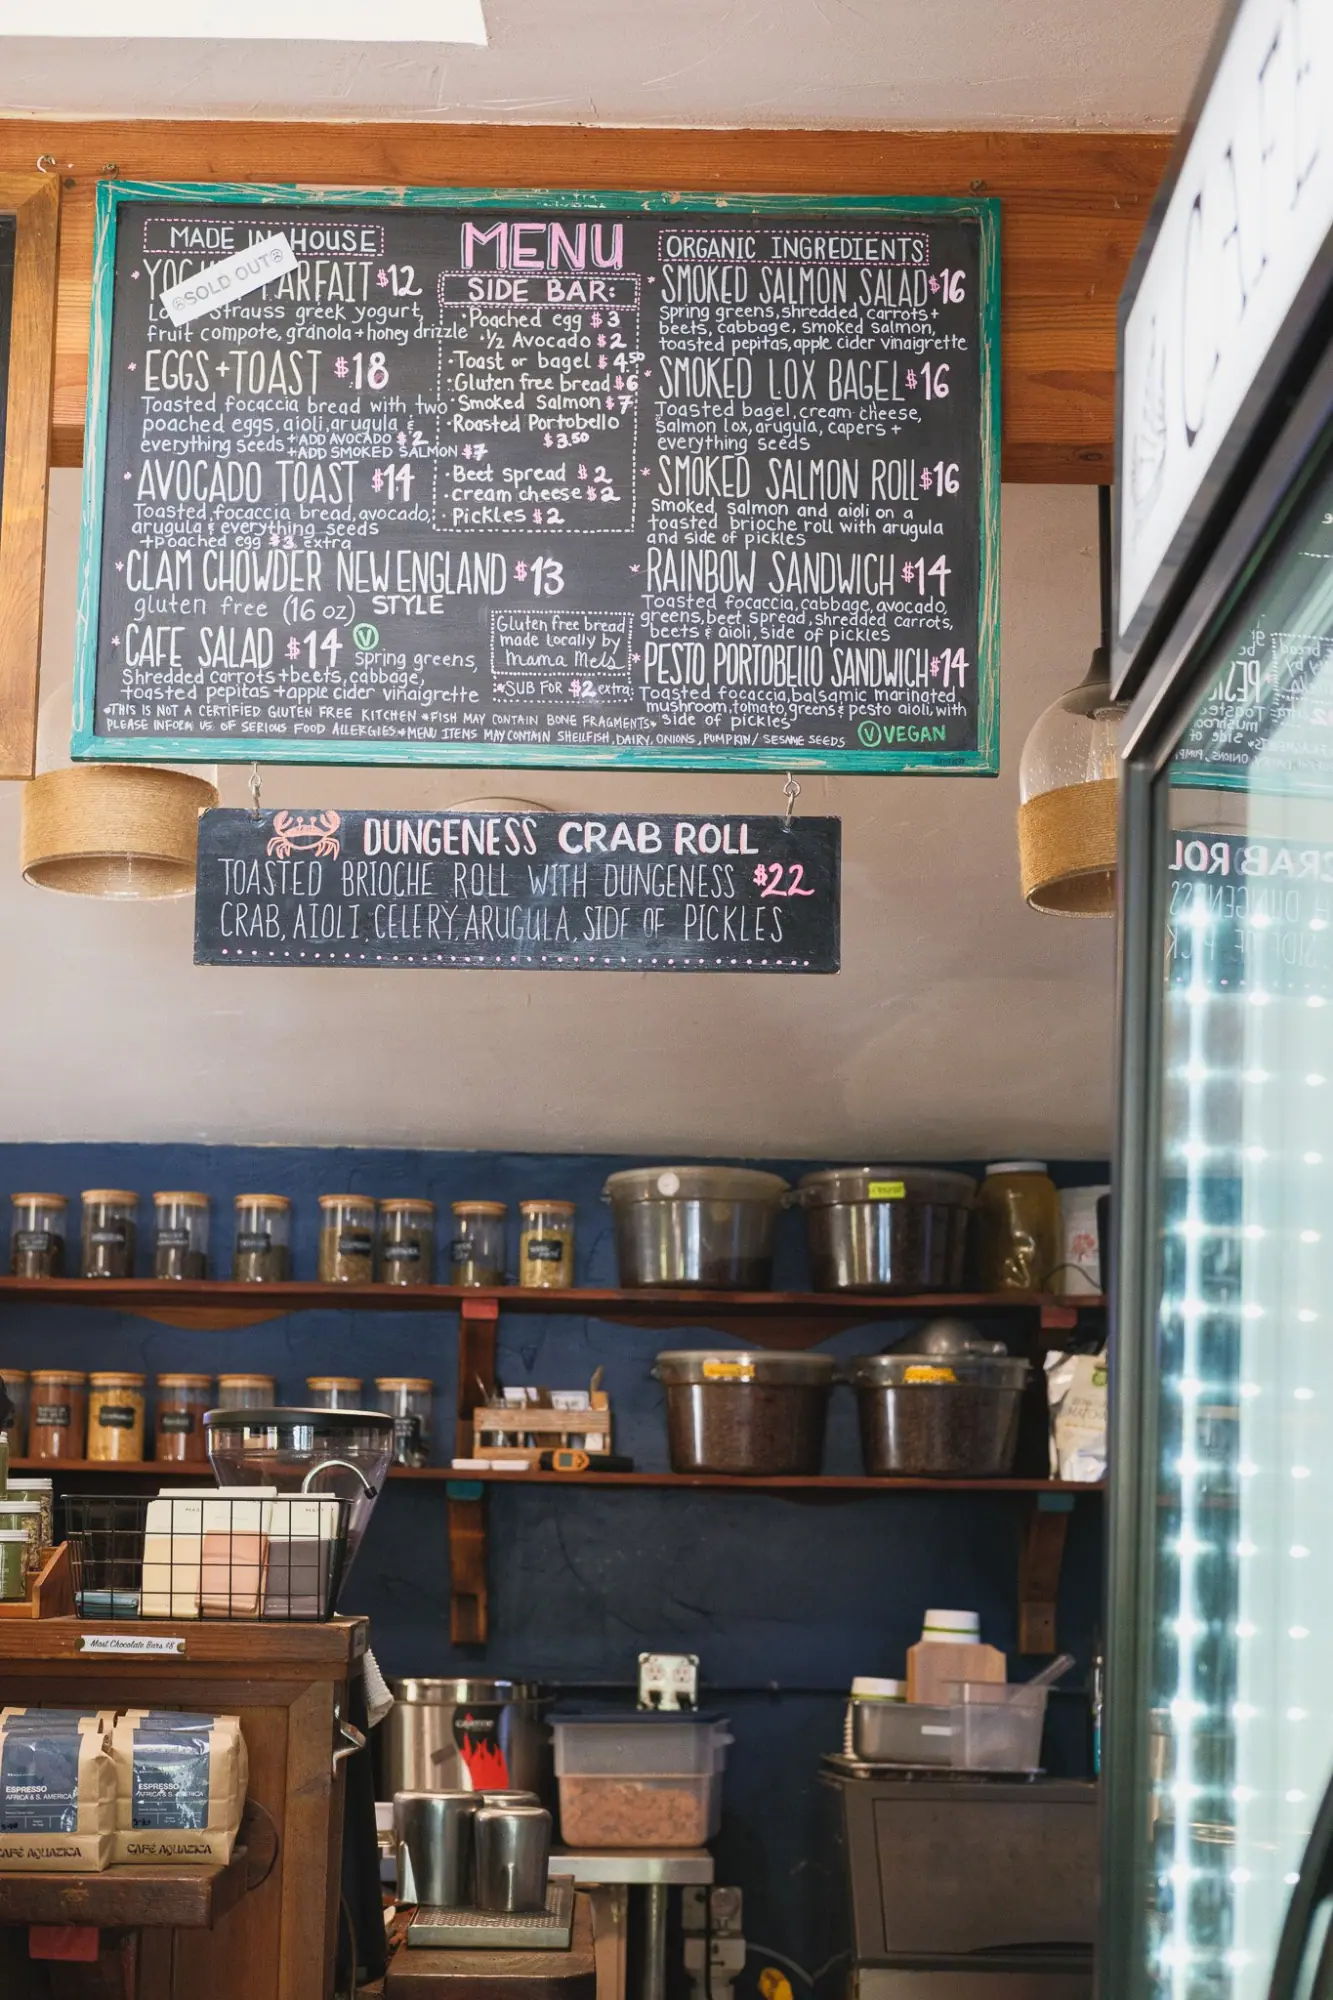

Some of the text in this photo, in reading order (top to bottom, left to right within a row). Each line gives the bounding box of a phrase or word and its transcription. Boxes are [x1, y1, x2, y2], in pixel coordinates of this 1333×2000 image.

[170, 226, 235, 249] MADE
[290, 228, 376, 252] HOUSE
[460, 221, 623, 271] MENU
[666, 235, 924, 263] ORGANIC INGREDIENTS
[184, 274, 231, 305] SOLD
[235, 253, 271, 281] OUT
[376, 264, 423, 297] $12
[468, 277, 616, 303] SIDE BAR:
[661, 264, 967, 308] SMOKED SALMON SALAD $16
[469, 307, 543, 328] Poached
[552, 313, 582, 333] egg
[715, 305, 780, 323] greens,
[659, 318, 936, 337] beets, cabbage, smoked salmon,
[512, 331, 592, 349] Avocado
[659, 336, 725, 352] toasted
[793, 336, 831, 355] apple
[837, 335, 875, 350] cider
[881, 334, 968, 355] vinaigrette
[145, 349, 209, 392] EGGS
[334, 351, 389, 390] $18
[453, 350, 505, 370] Toast
[511, 357, 528, 368] or
[537, 351, 592, 374] bagel
[454, 372, 639, 392] Gluten free bread $6
[659, 356, 950, 402] SMOKED LOX BAGEL $16
[141, 392, 448, 414] Toasted focaccia bread with two
[458, 393, 634, 415] Smoked Salmon $7
[453, 413, 620, 433] Roasted Portobello
[543, 432, 590, 449] $3.50
[657, 434, 810, 455] everything seeds
[137, 459, 415, 504] AVOCADO TOAST $14
[453, 463, 494, 483] Beet
[502, 462, 567, 488] spread
[658, 455, 960, 501] SMOKED SALMON ROLL $16
[451, 485, 621, 502] cream cheese $2
[452, 507, 565, 527] Pickles $2
[648, 513, 944, 542] toasted brioche roll with arugula
[647, 530, 806, 550] and side of pickles
[126, 549, 565, 596] CLAM CHOWDER NEW ENGLAND $13
[647, 547, 951, 597] RAINBOW SANDWICH $14
[134, 593, 206, 621] gluten
[221, 595, 268, 617] free
[372, 595, 444, 616] STYLE
[497, 614, 626, 633] Gluten free bread
[125, 623, 343, 669] CAFE SALAD $14
[500, 632, 539, 647] made
[602, 633, 621, 654] by
[644, 641, 970, 688] PESTO PORTOBELLO SANDWICH $14
[540, 681, 562, 695] FOR
[568, 679, 597, 698] $2
[598, 683, 630, 695] extra
[362, 708, 417, 722] KITCHEN
[463, 712, 649, 729] MAY CONTAIN BONE FRAGMENTS
[884, 725, 946, 744] VEGAN
[363, 817, 759, 856] DUNGENESS CRAB ROLL
[218, 858, 815, 899] TOASTED BRIOCHE ROLL WITH DUNGENESS $22
[220, 901, 286, 942] CRAB,
[374, 900, 459, 941] CELERY,
[464, 903, 578, 943] ARUGULA,
[583, 905, 631, 941] SIDE
[643, 907, 664, 938] OF
[685, 904, 783, 942] PICKLES
[110, 1639, 144, 1649] Chocolate
[146, 1640, 163, 1649] Bars
[5, 1785, 47, 1793] ESPRESSO
